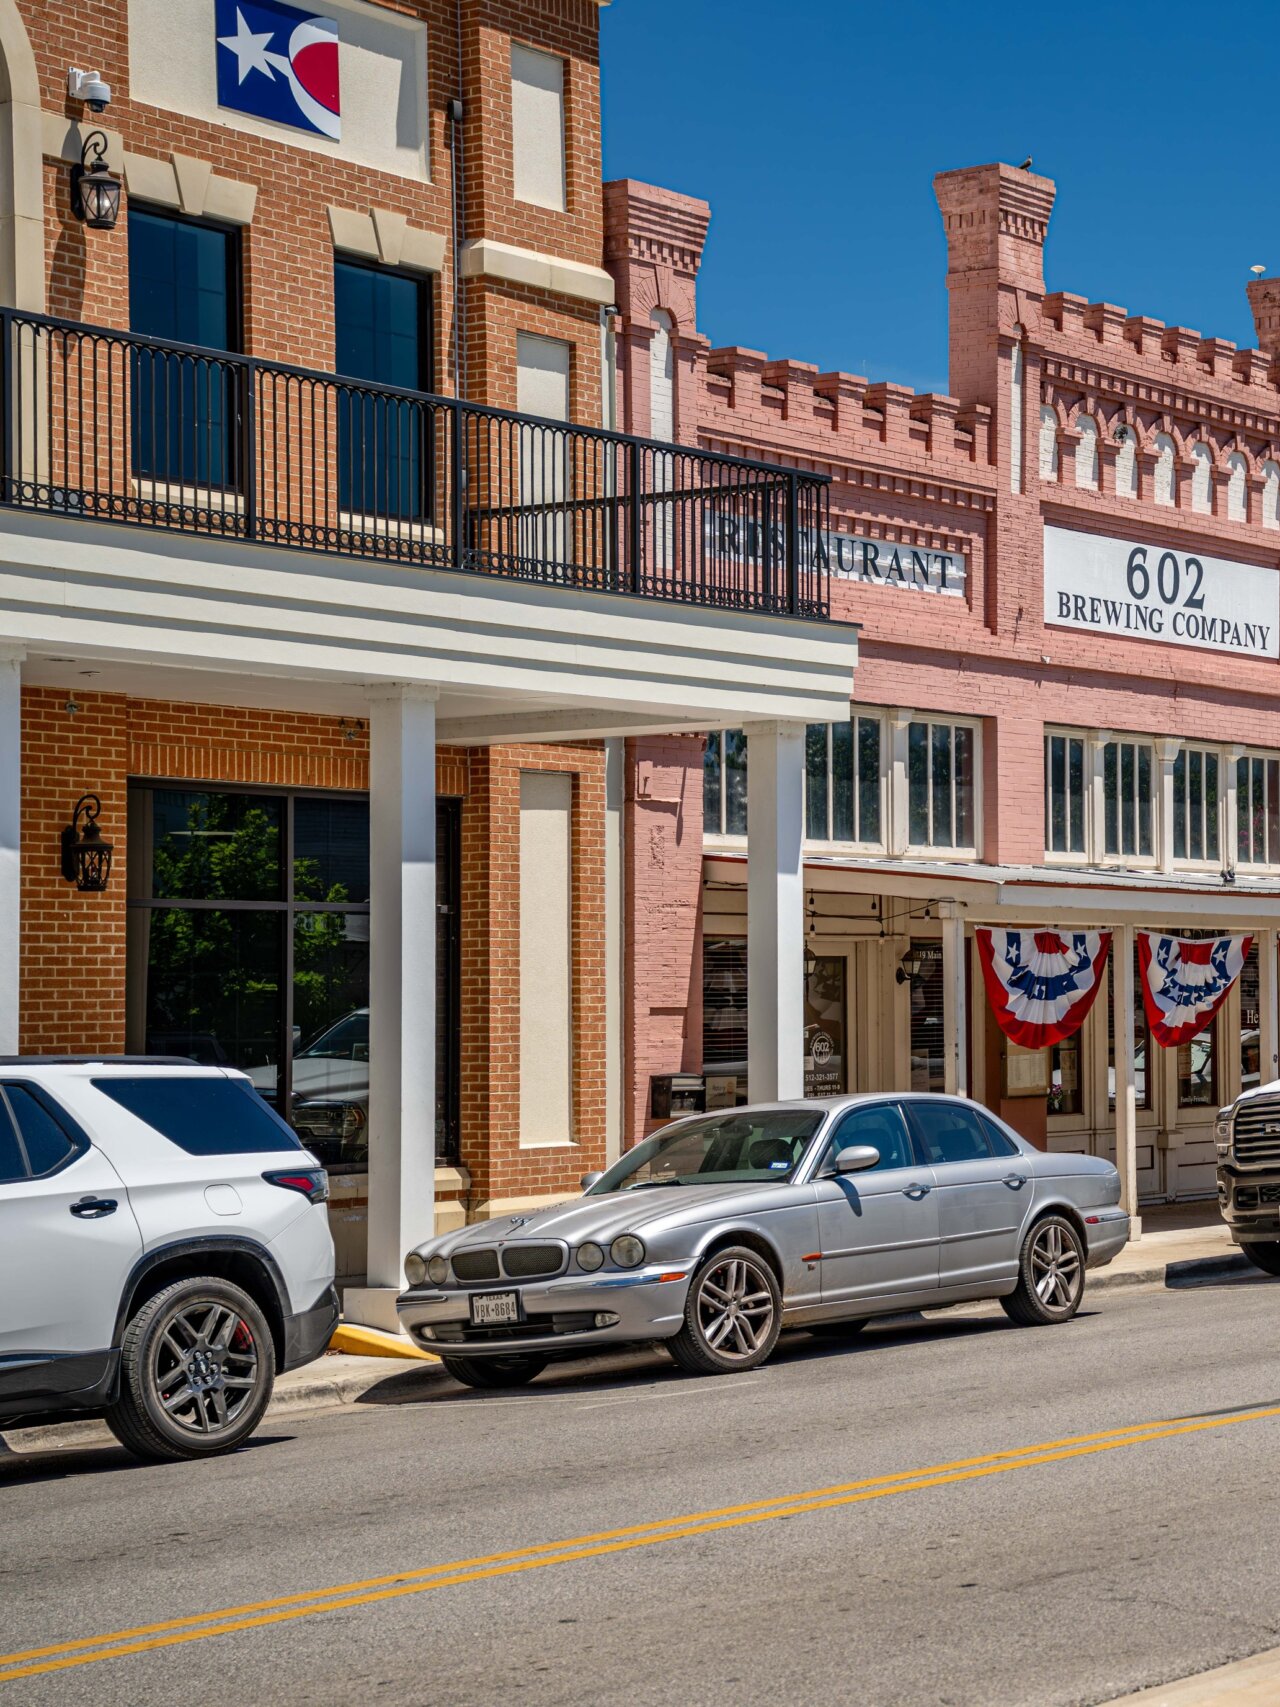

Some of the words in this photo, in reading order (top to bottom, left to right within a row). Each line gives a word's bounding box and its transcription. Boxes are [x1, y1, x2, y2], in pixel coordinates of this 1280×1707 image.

[1127, 546, 1206, 610] 602
[1057, 591, 1164, 633] BREWING
[1173, 611, 1271, 650] COMPANY
[815, 1042, 830, 1052] 602
